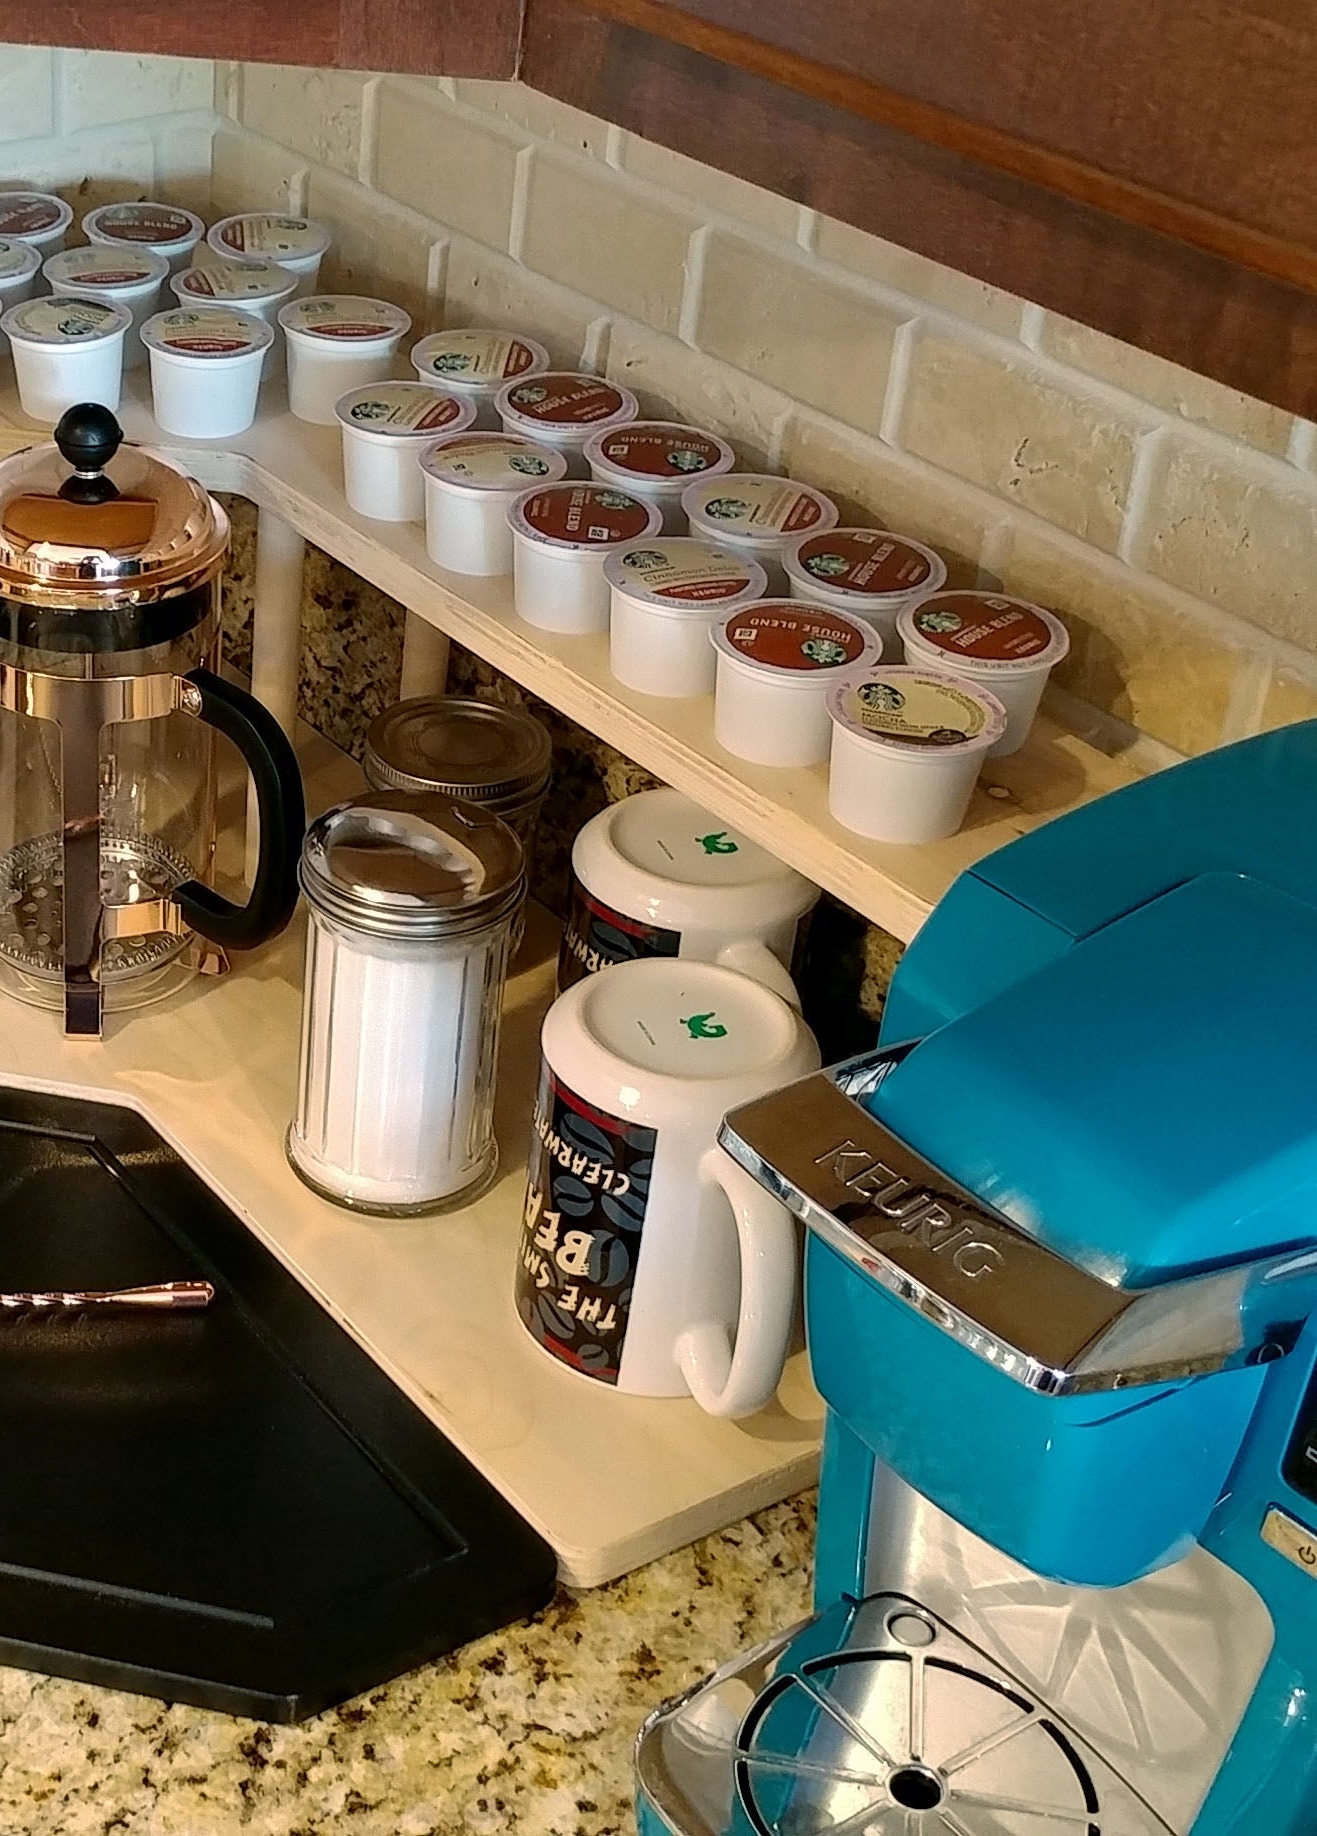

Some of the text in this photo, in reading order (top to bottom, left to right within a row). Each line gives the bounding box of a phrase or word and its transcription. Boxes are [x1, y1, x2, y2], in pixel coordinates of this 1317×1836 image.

[749, 618, 851, 644] HOUSE BLEND
[955, 625, 994, 648] HOUSE
[524, 1182, 595, 1278] BEA
[814, 1140, 1005, 1278] KEURIG
[556, 1284, 618, 1331] THE
